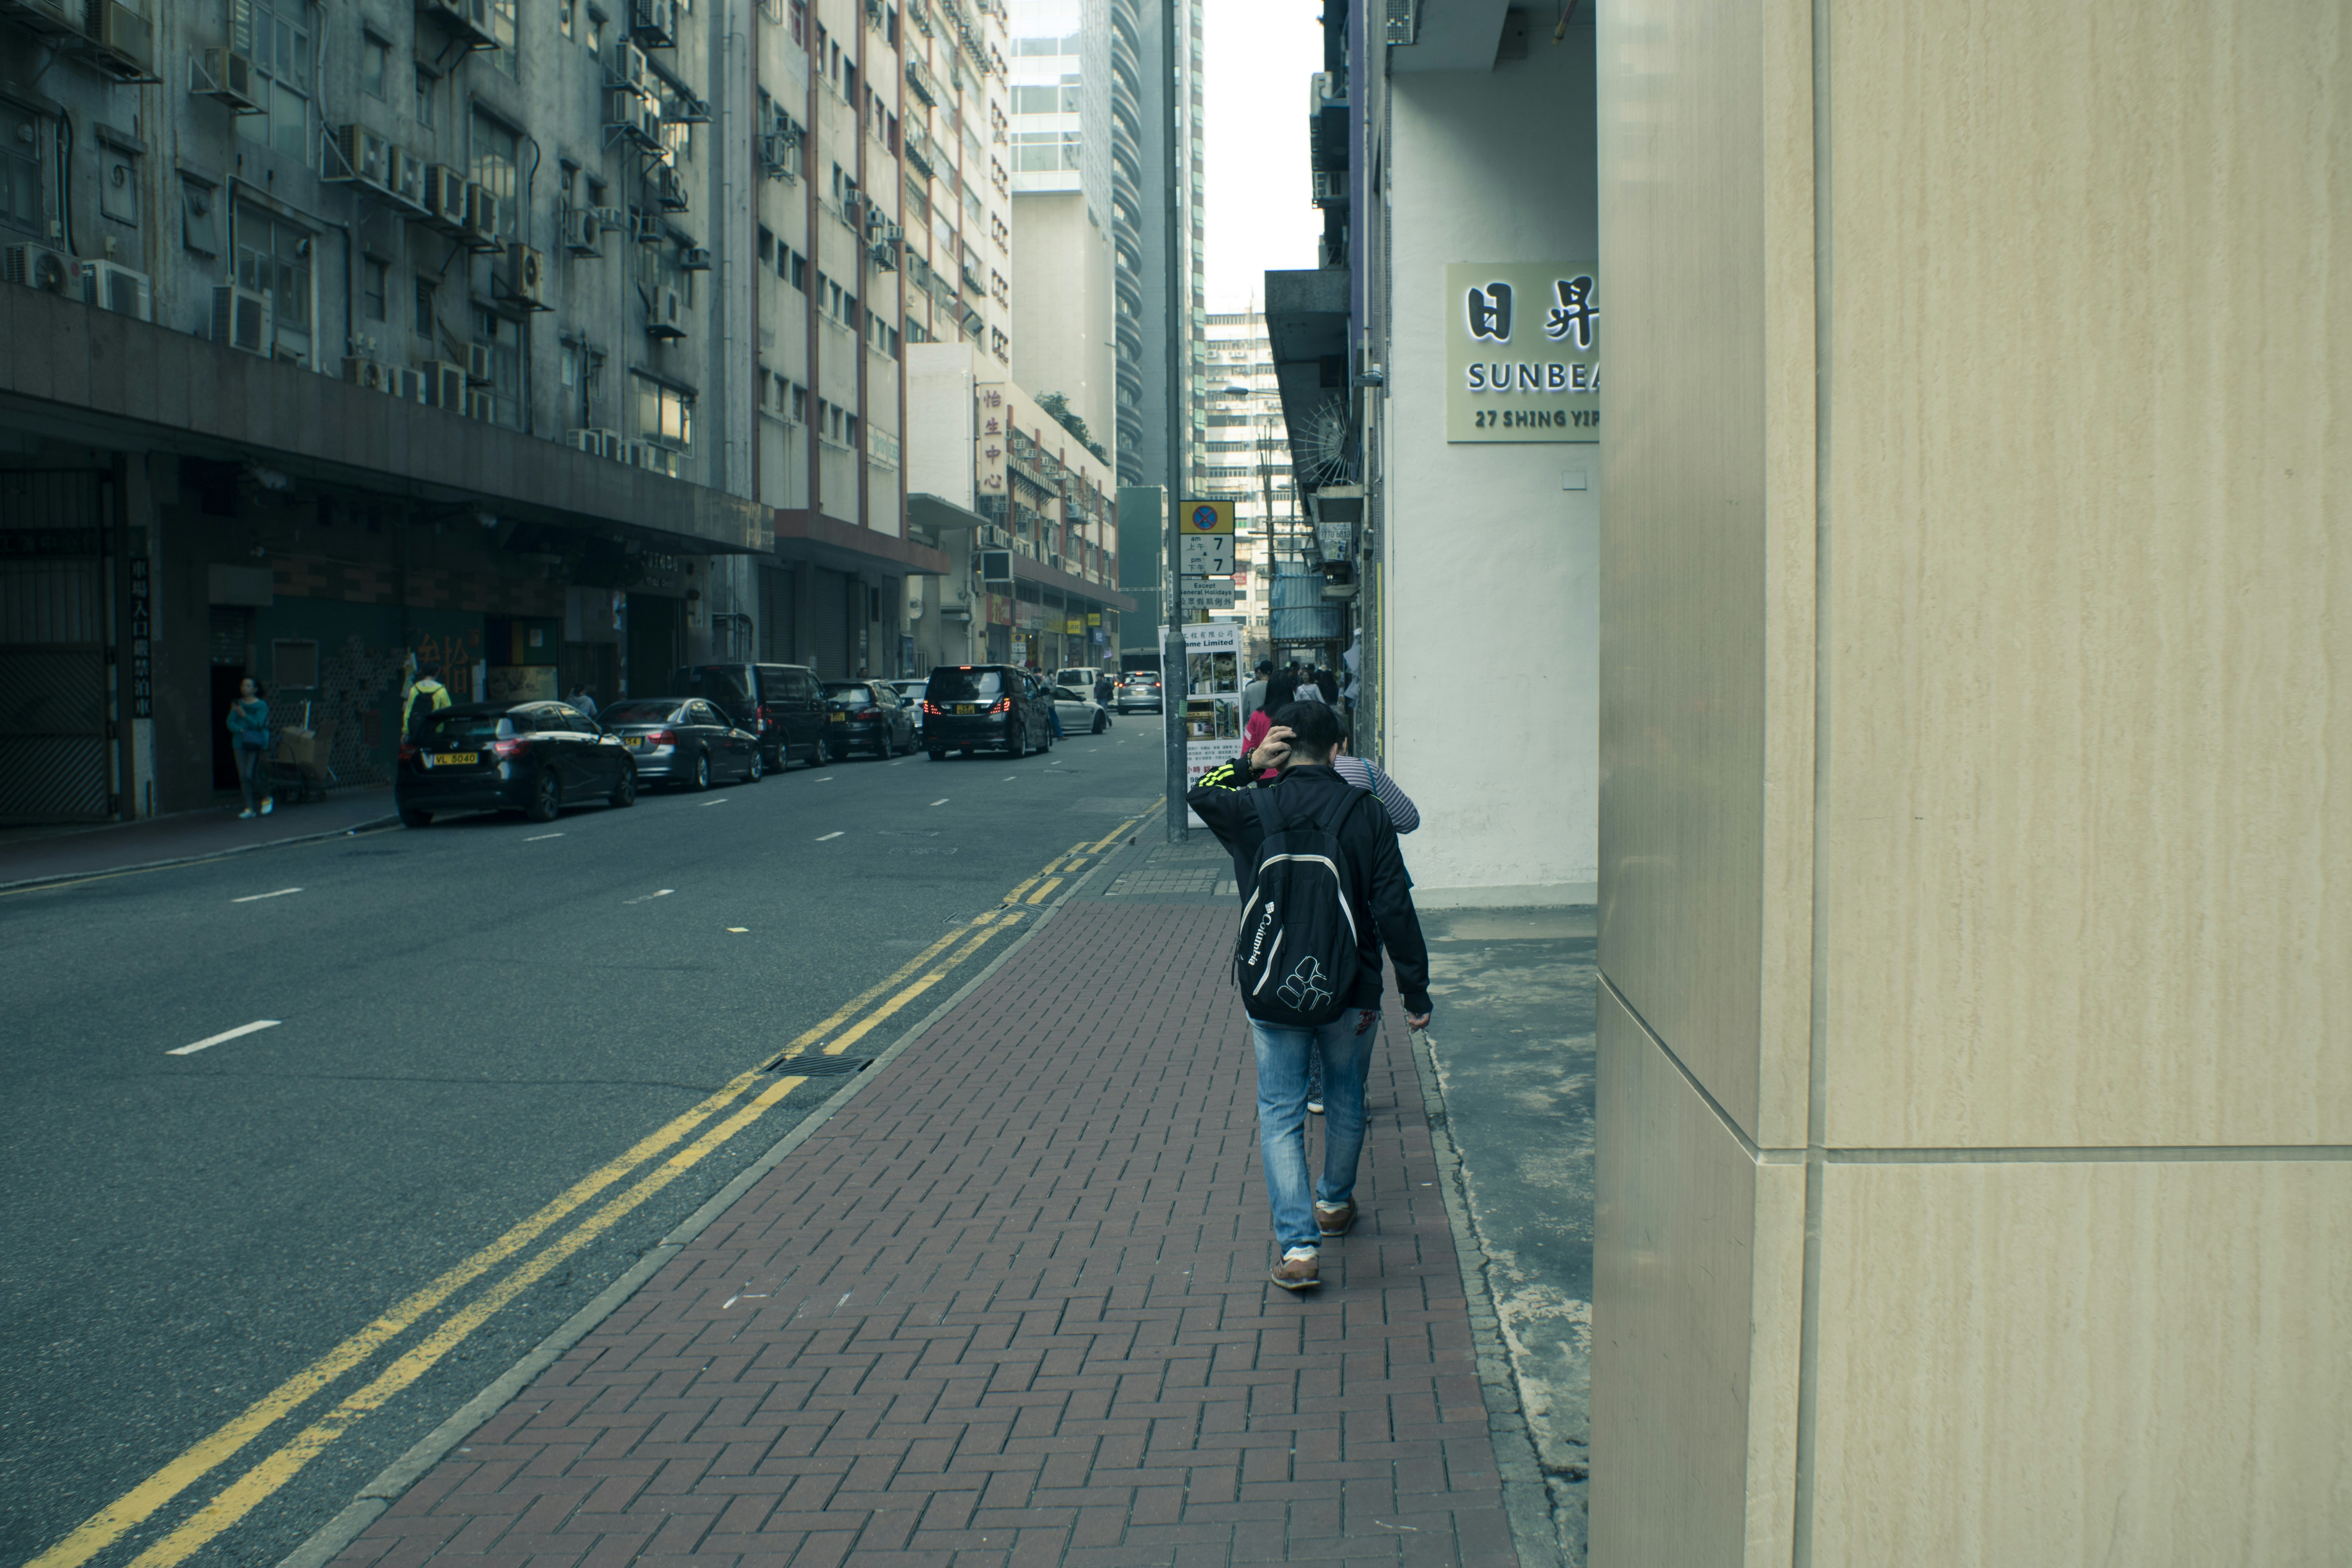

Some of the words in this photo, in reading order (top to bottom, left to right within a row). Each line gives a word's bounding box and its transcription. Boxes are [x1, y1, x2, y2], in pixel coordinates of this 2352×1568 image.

[1475, 410, 1497, 427] 27
[1503, 410, 1566, 427] SHING
[984, 390, 1002, 488] 怡生中心
[1214, 537, 1223, 550] 7
[1214, 559, 1223, 571] 7
[452, 754, 475, 763] 5040
[1248, 914, 1271, 965] Columbia
